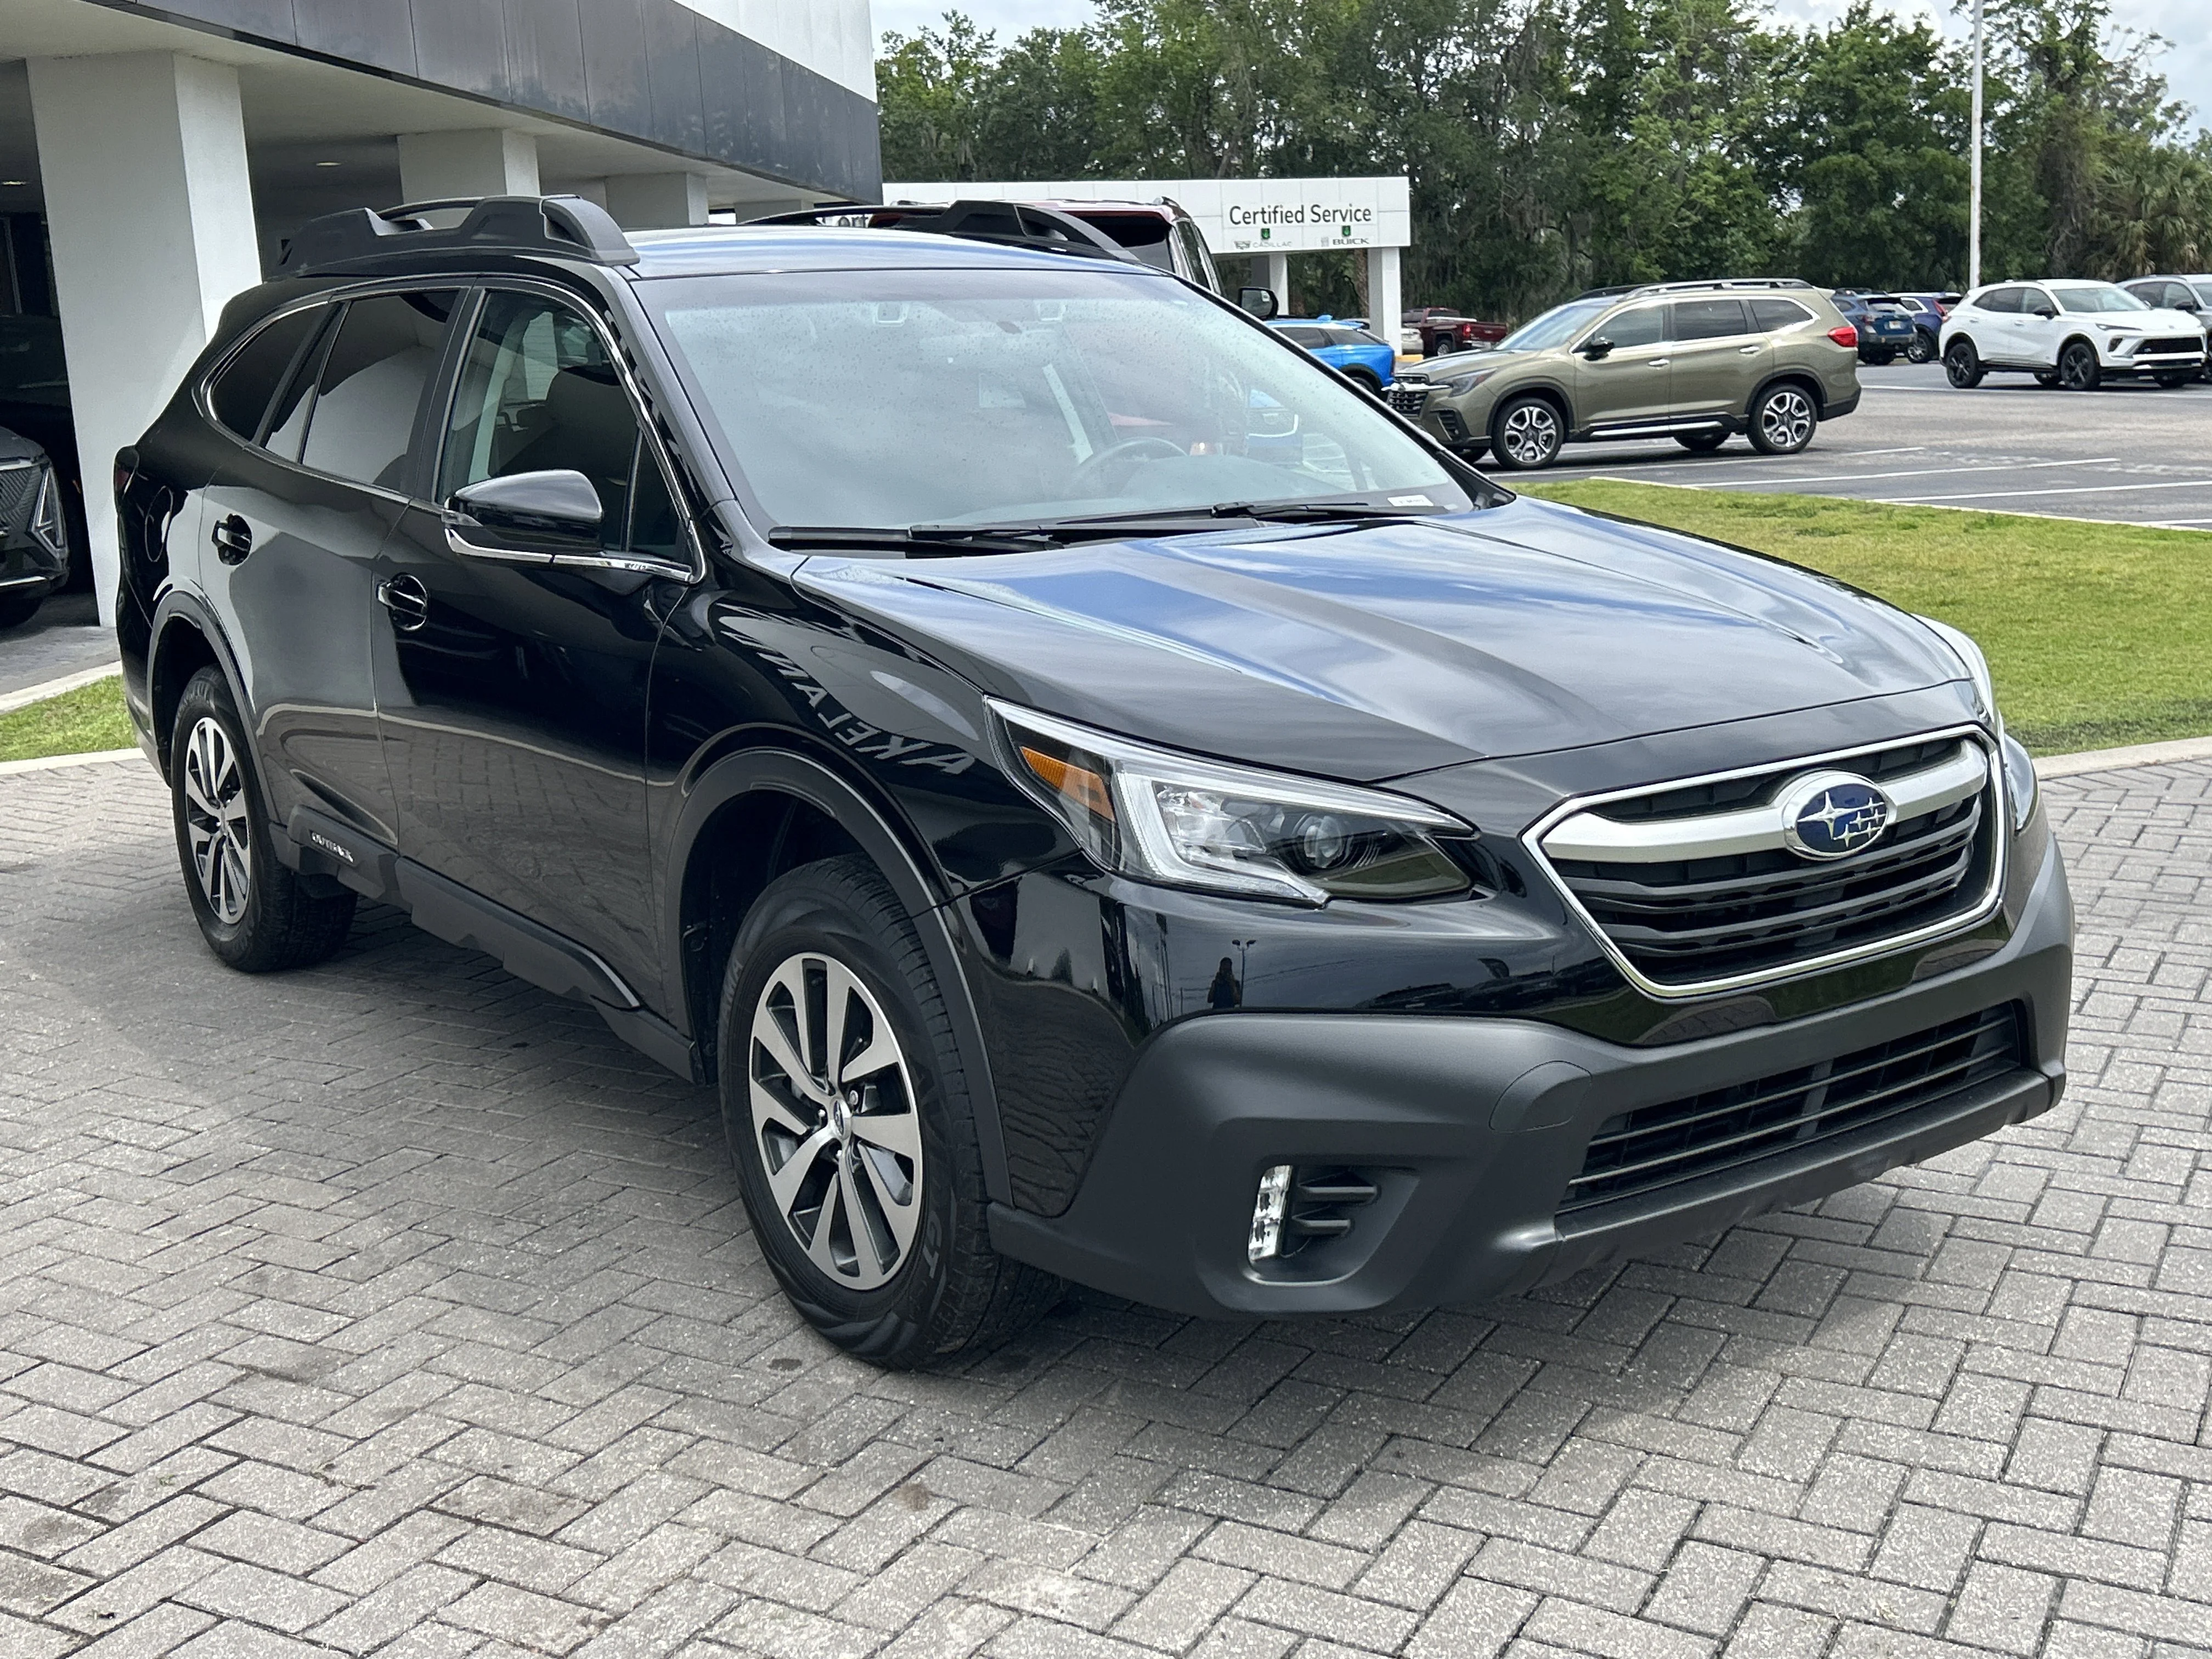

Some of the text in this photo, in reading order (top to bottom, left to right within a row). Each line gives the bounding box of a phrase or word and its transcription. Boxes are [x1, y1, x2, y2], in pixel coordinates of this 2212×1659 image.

[1229, 203, 1372, 225] Certified Service
[1332, 237, 1370, 246] BUICK
